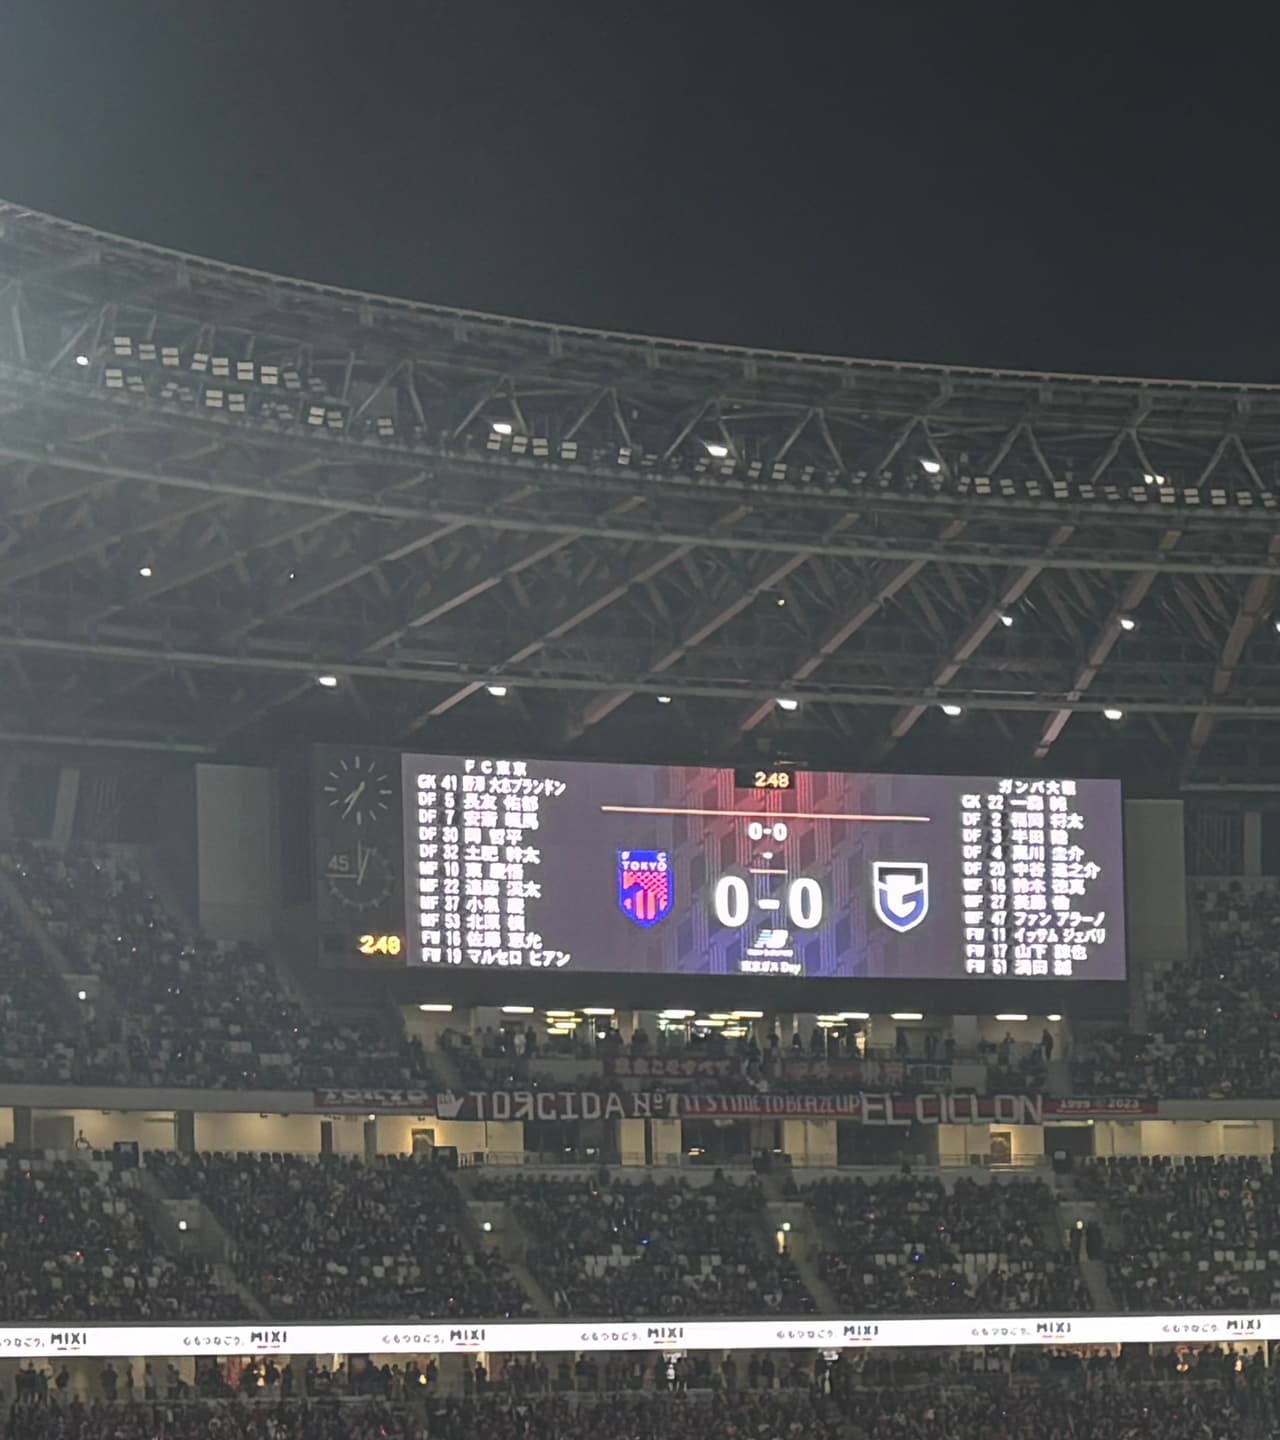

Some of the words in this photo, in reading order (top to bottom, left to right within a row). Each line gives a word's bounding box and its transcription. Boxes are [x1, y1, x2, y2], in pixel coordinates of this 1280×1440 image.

[418, 792, 436, 806] DF
[419, 809, 437, 823] DF
[445, 809, 455, 825] 7
[991, 812, 1001, 827] 2
[419, 826, 437, 840] DF
[992, 829, 1002, 843] 3
[419, 844, 438, 858] DF
[328, 855, 350, 872] 45
[444, 878, 459, 894] 22
[715, 875, 823, 929] 0-0
[992, 928, 1005, 942] 11
[358, 935, 401, 955] 248
[844, 1325, 878, 1336] MIXI
[1037, 1322, 1070, 1333] MIXI
[1227, 1319, 1260, 1330] MIXI
[51, 1332, 86, 1345] MIXI
[251, 1331, 286, 1343] MIXI
[451, 1329, 484, 1341] MIXI
[648, 1327, 682, 1338] MIXI
